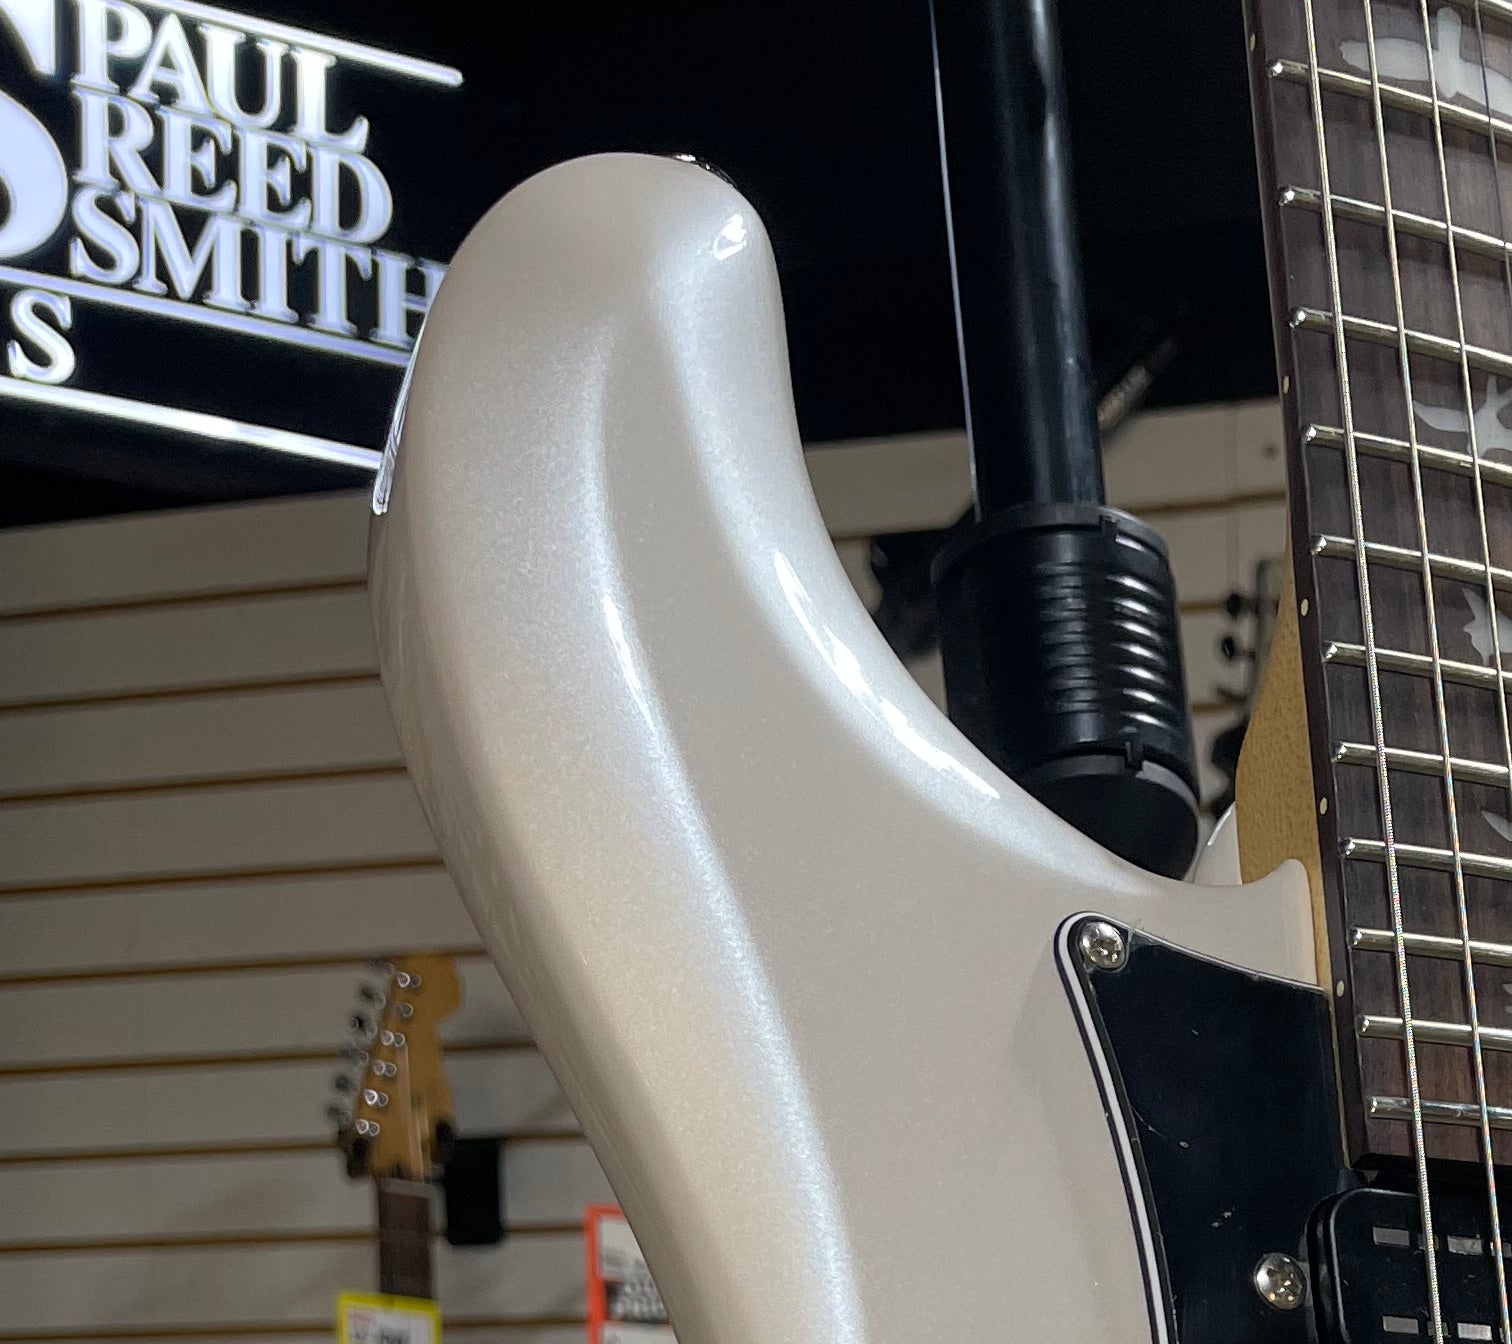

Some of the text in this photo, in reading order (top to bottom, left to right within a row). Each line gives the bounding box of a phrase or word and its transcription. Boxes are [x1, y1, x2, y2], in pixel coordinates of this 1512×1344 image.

[71, 0, 370, 156] PAUL
[73, 88, 394, 246] REED
[69, 187, 451, 347] SMITH
